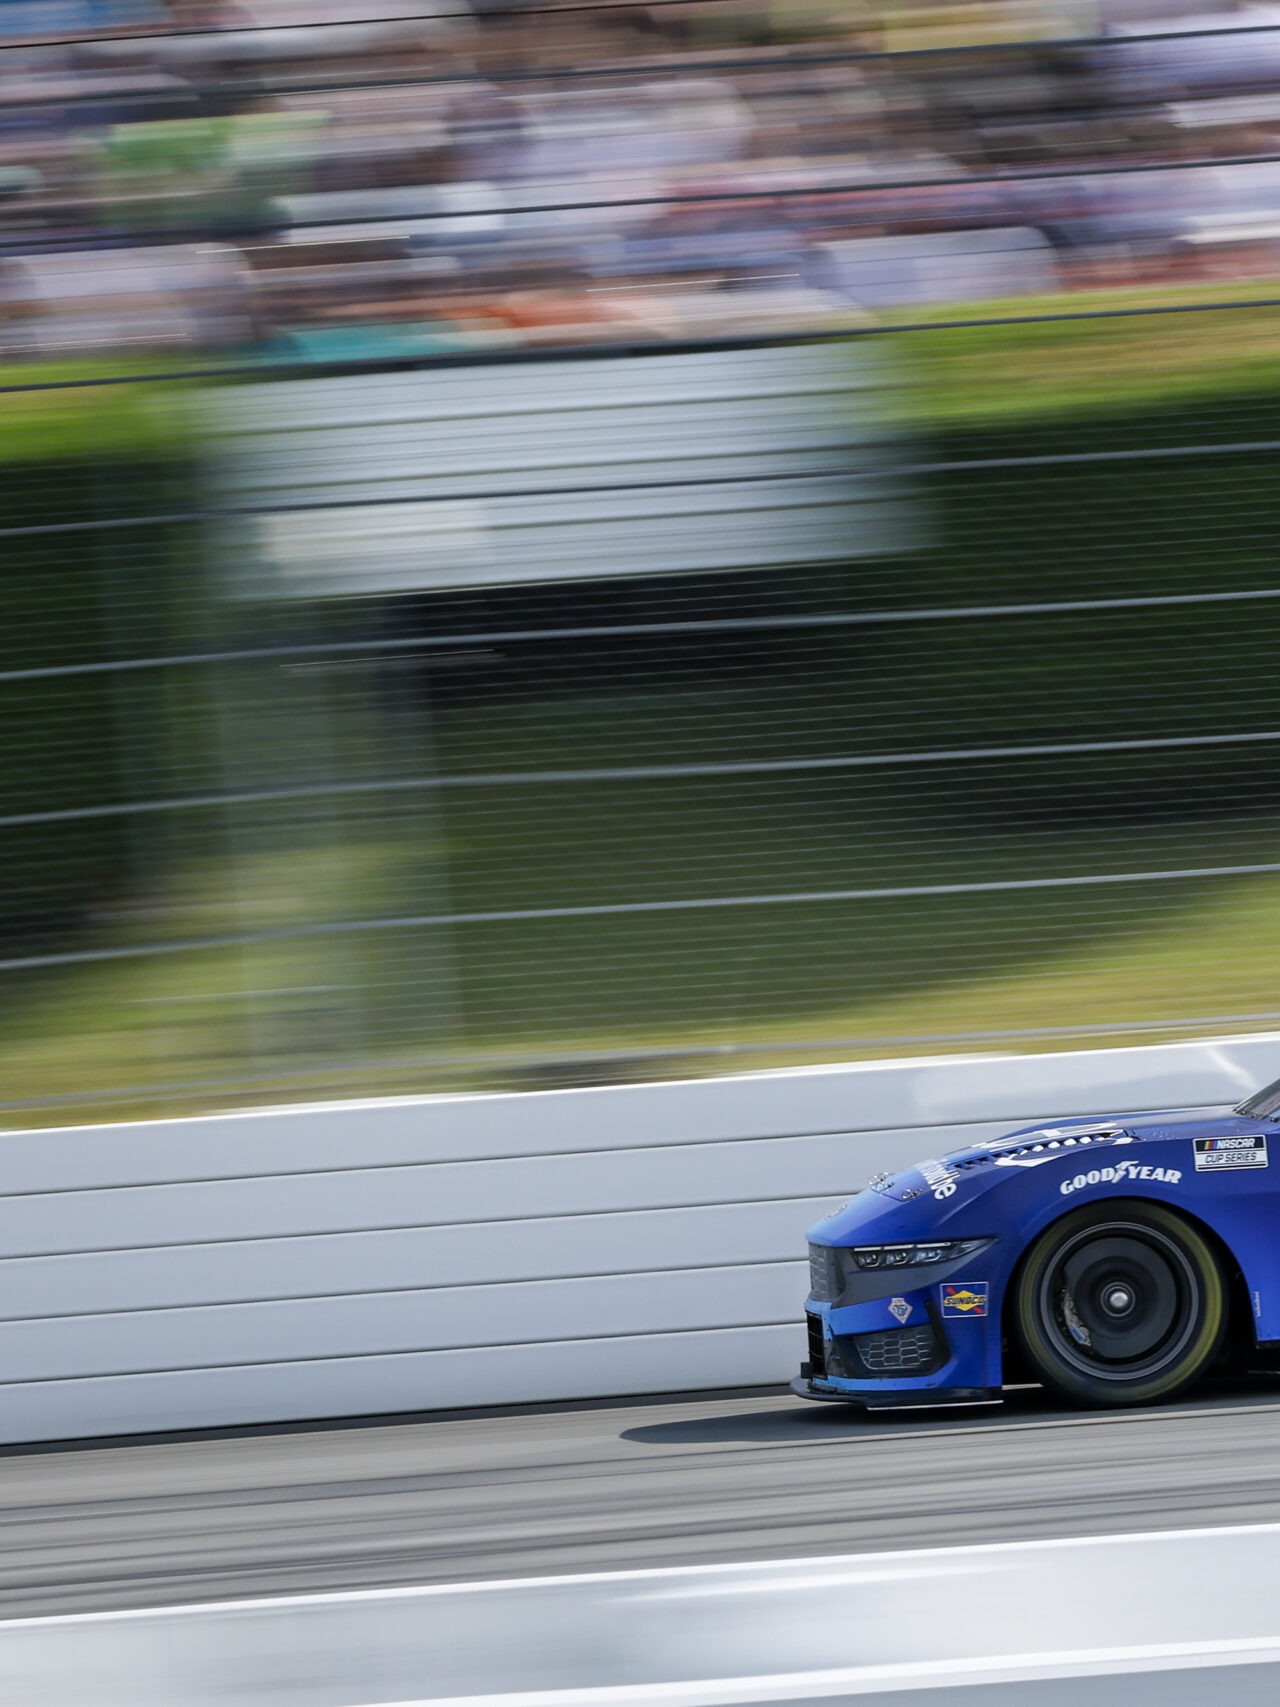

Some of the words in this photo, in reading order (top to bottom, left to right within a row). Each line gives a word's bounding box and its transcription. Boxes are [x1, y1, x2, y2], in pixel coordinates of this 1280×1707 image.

[1217, 1138, 1255, 1149] NASCAR
[1205, 1154, 1223, 1163] CUP
[1224, 1152, 1256, 1162] SERIES
[1060, 1161, 1182, 1195] GOODYEAR
[944, 1297, 986, 1305] SUNOCO
